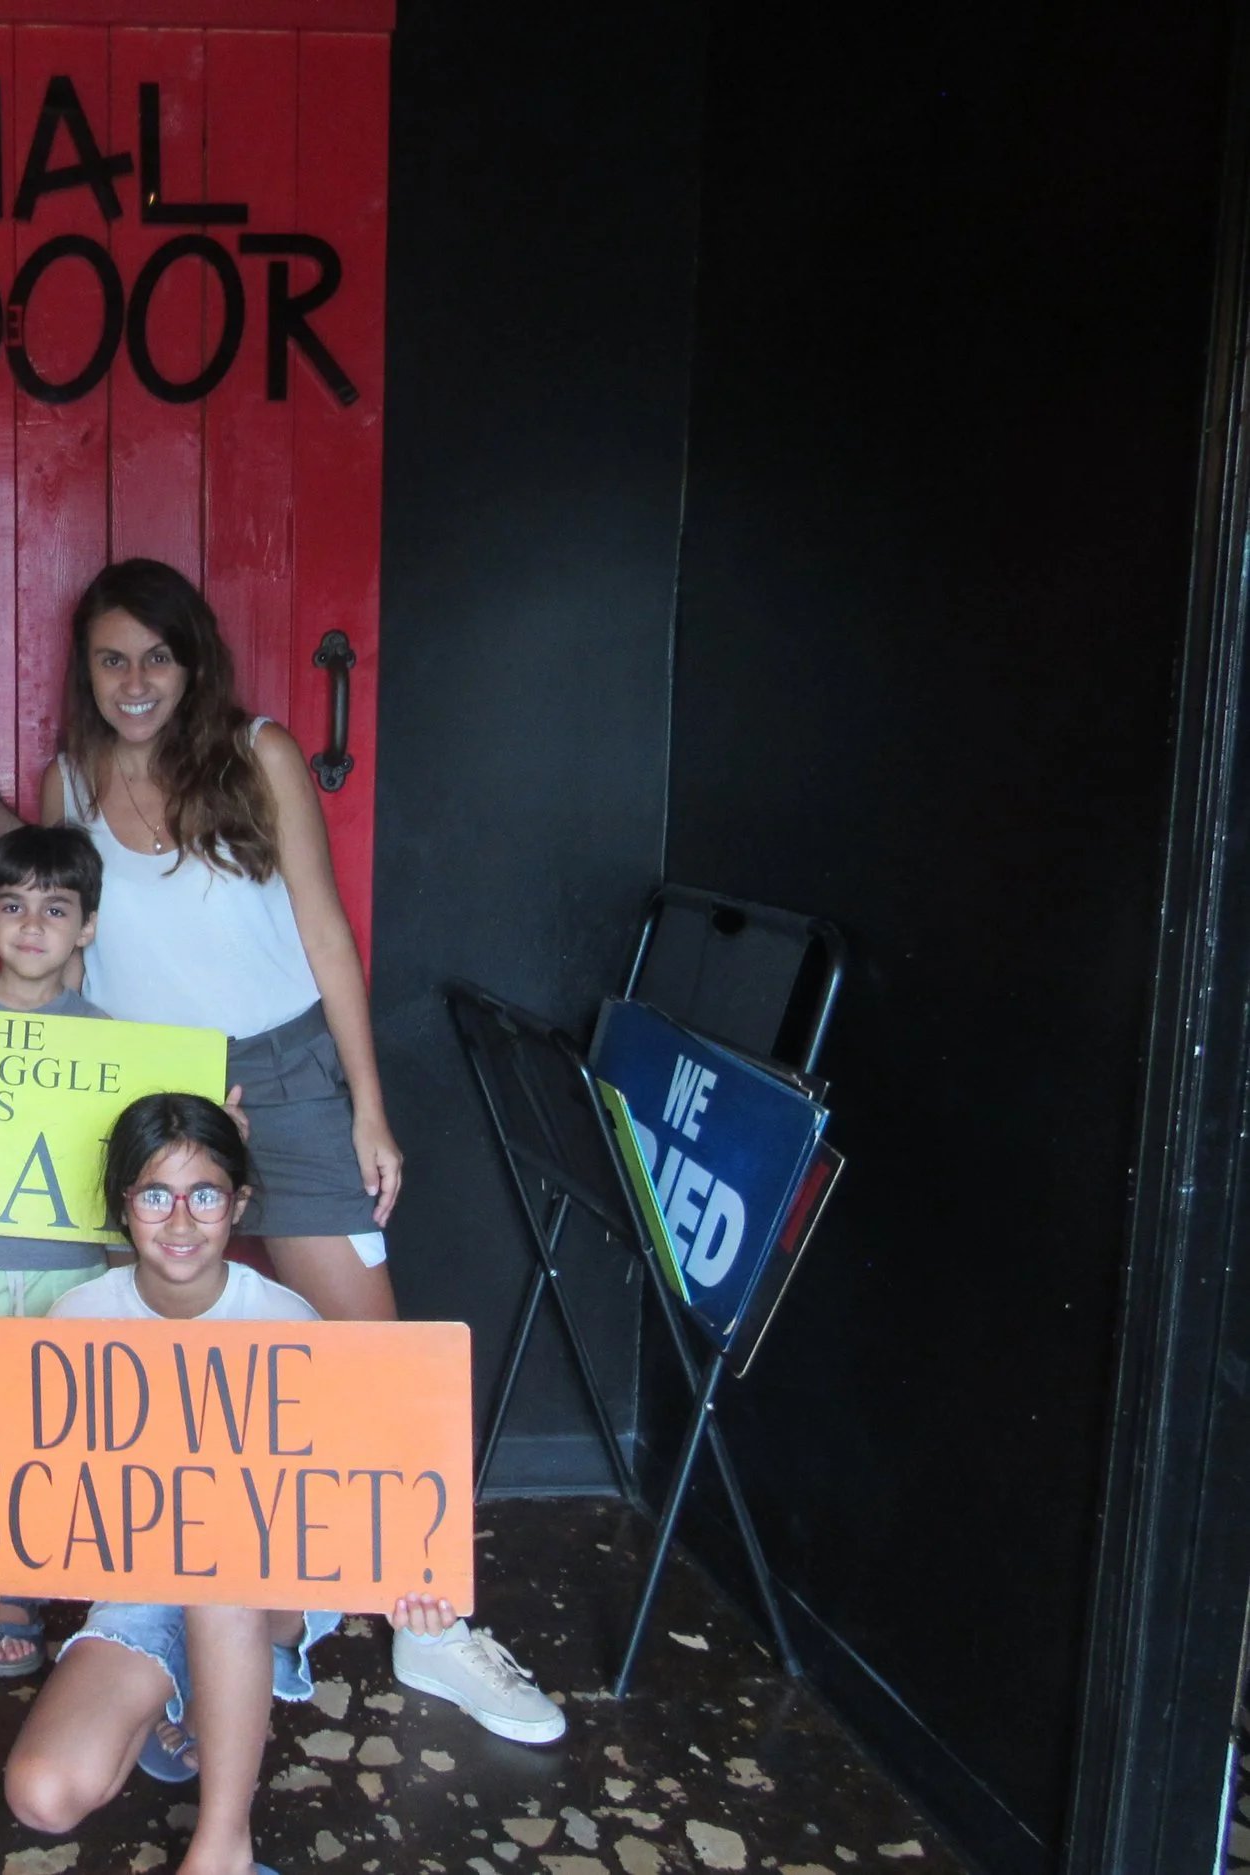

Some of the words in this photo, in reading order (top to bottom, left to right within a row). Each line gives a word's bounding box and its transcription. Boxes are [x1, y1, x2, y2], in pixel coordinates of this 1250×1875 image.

[662, 1053, 718, 1142] WE
[30, 1339, 151, 1453] DID
[173, 1343, 313, 1456] WE
[241, 1467, 448, 1584] YET?
